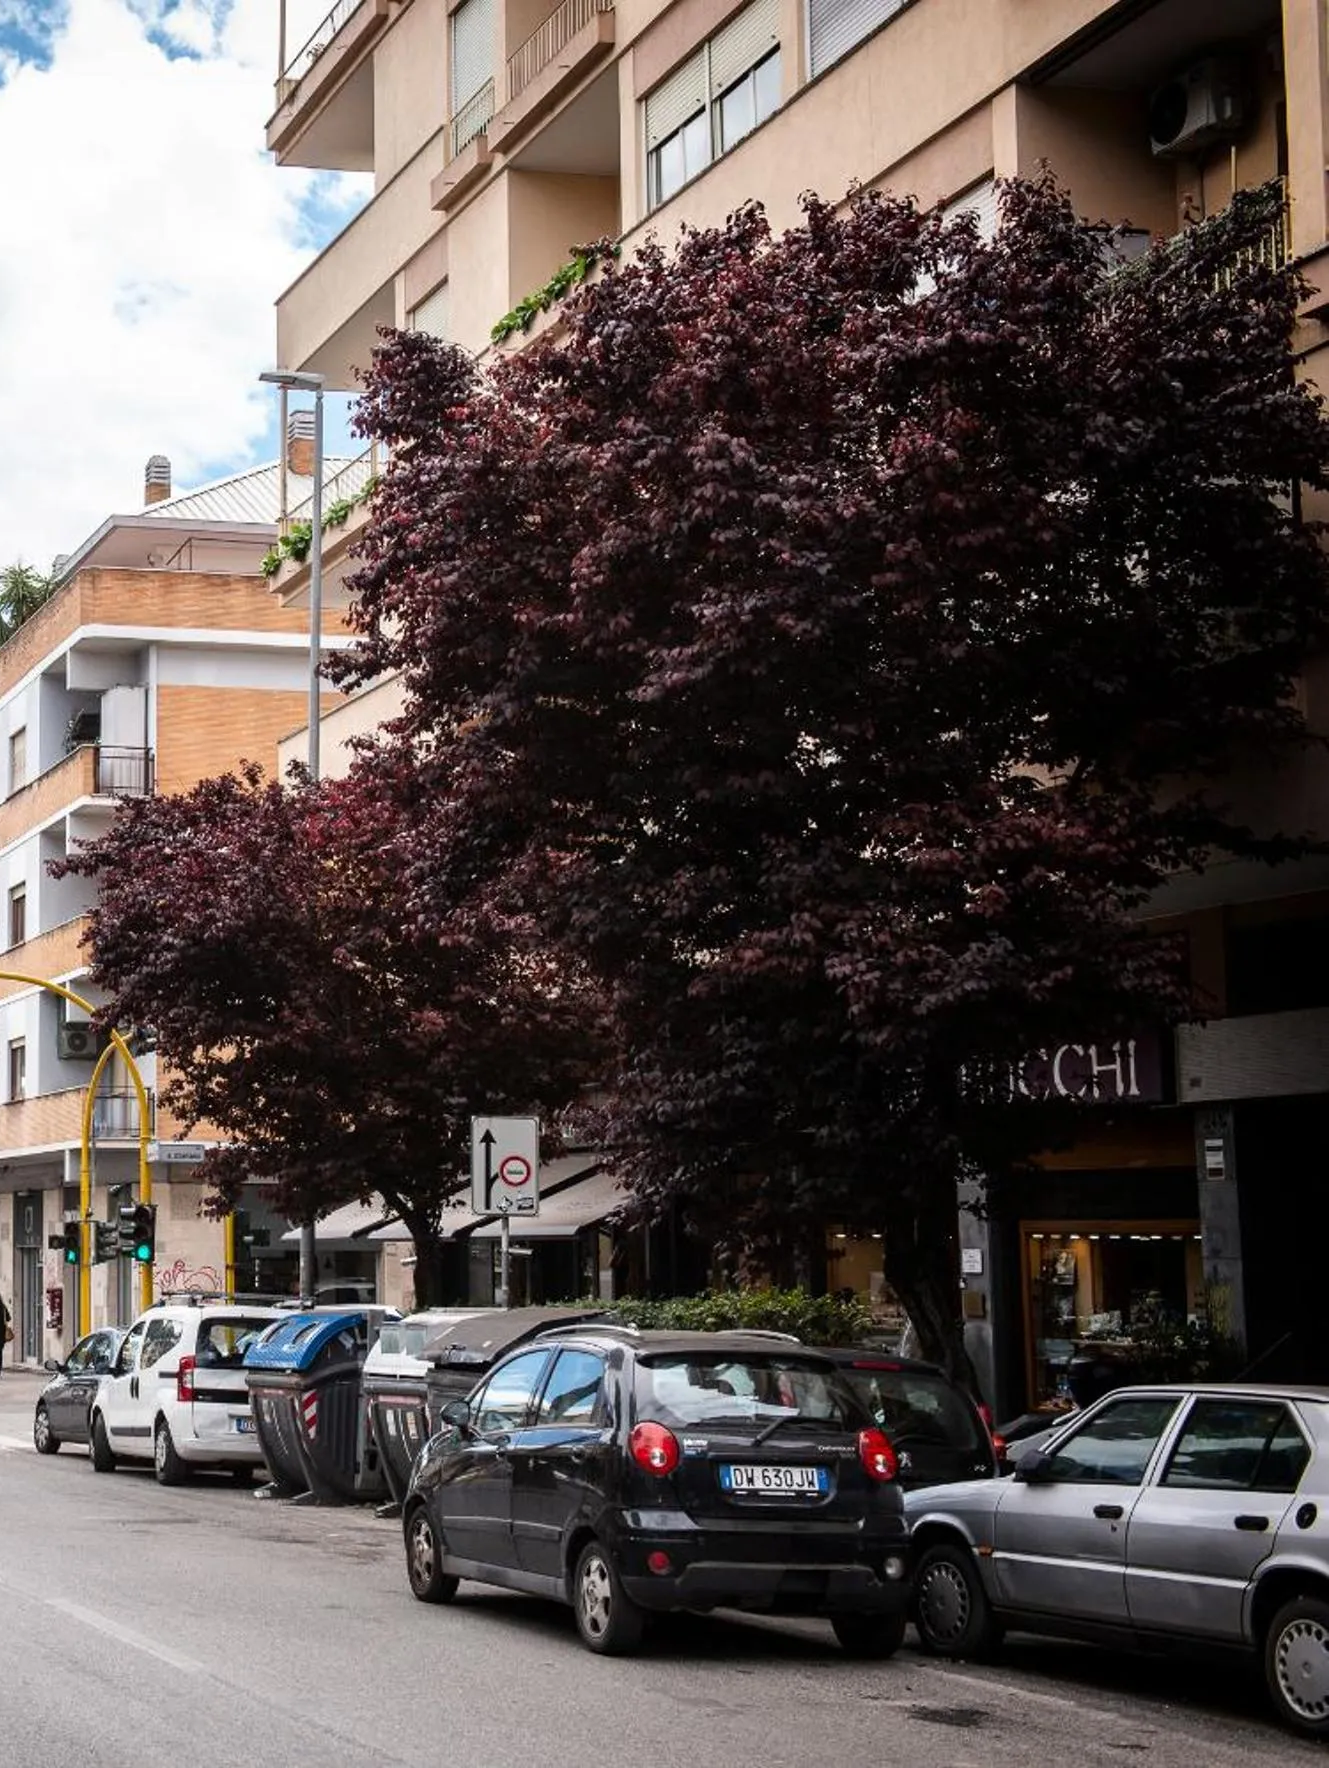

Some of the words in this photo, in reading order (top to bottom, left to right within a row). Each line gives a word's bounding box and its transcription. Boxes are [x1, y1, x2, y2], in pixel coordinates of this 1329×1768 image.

[960, 1039, 1141, 1105] CCHI
[733, 1468, 755, 1487] DW
[761, 1468, 817, 1488] 630JW
